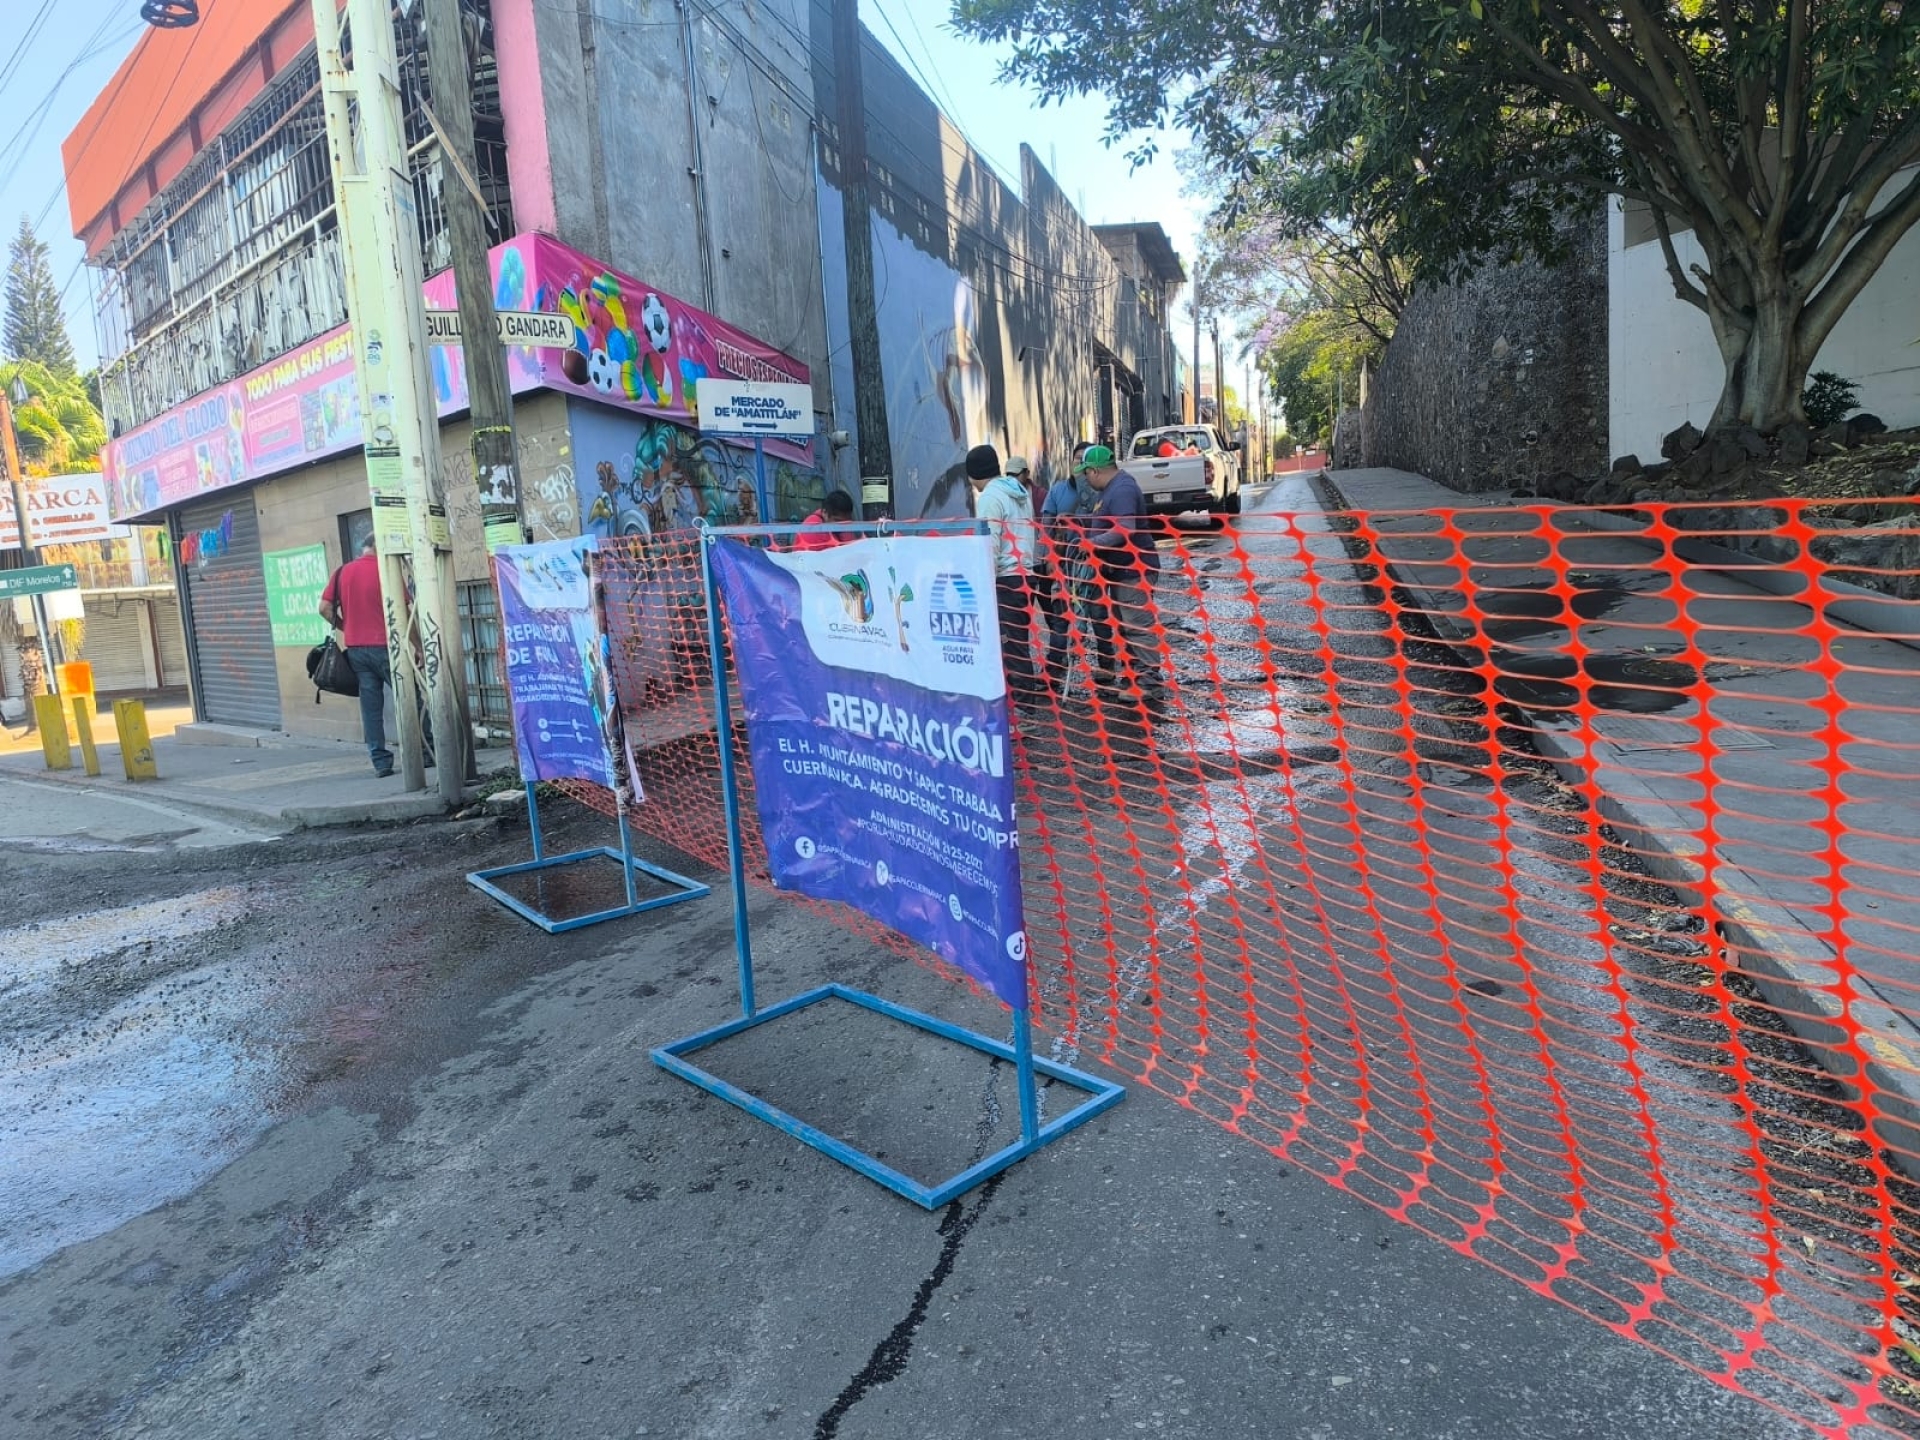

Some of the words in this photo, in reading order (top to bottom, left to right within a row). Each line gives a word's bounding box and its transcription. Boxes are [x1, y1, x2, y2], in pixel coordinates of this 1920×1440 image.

[505, 316, 567, 339] GANDARA
[716, 338, 756, 382] PRECIOS
[246, 371, 272, 403] TODO
[273, 358, 300, 391] PARA
[300, 345, 325, 378] SUS
[714, 407, 730, 417] DE
[731, 396, 784, 408] MERCADO
[160, 415, 183, 449] DEL
[184, 393, 228, 439] GLOBO
[0, 488, 103, 514] NARCA
[9, 577, 24, 588] DIF
[26, 574, 61, 587] Morelos
[508, 647, 532, 666] DE
[827, 692, 1004, 777] REPARACIÓN
[778, 738, 796, 753] EL
[798, 739, 815, 754] H.
[904, 766, 913, 782] Y
[951, 811, 970, 832] TU
